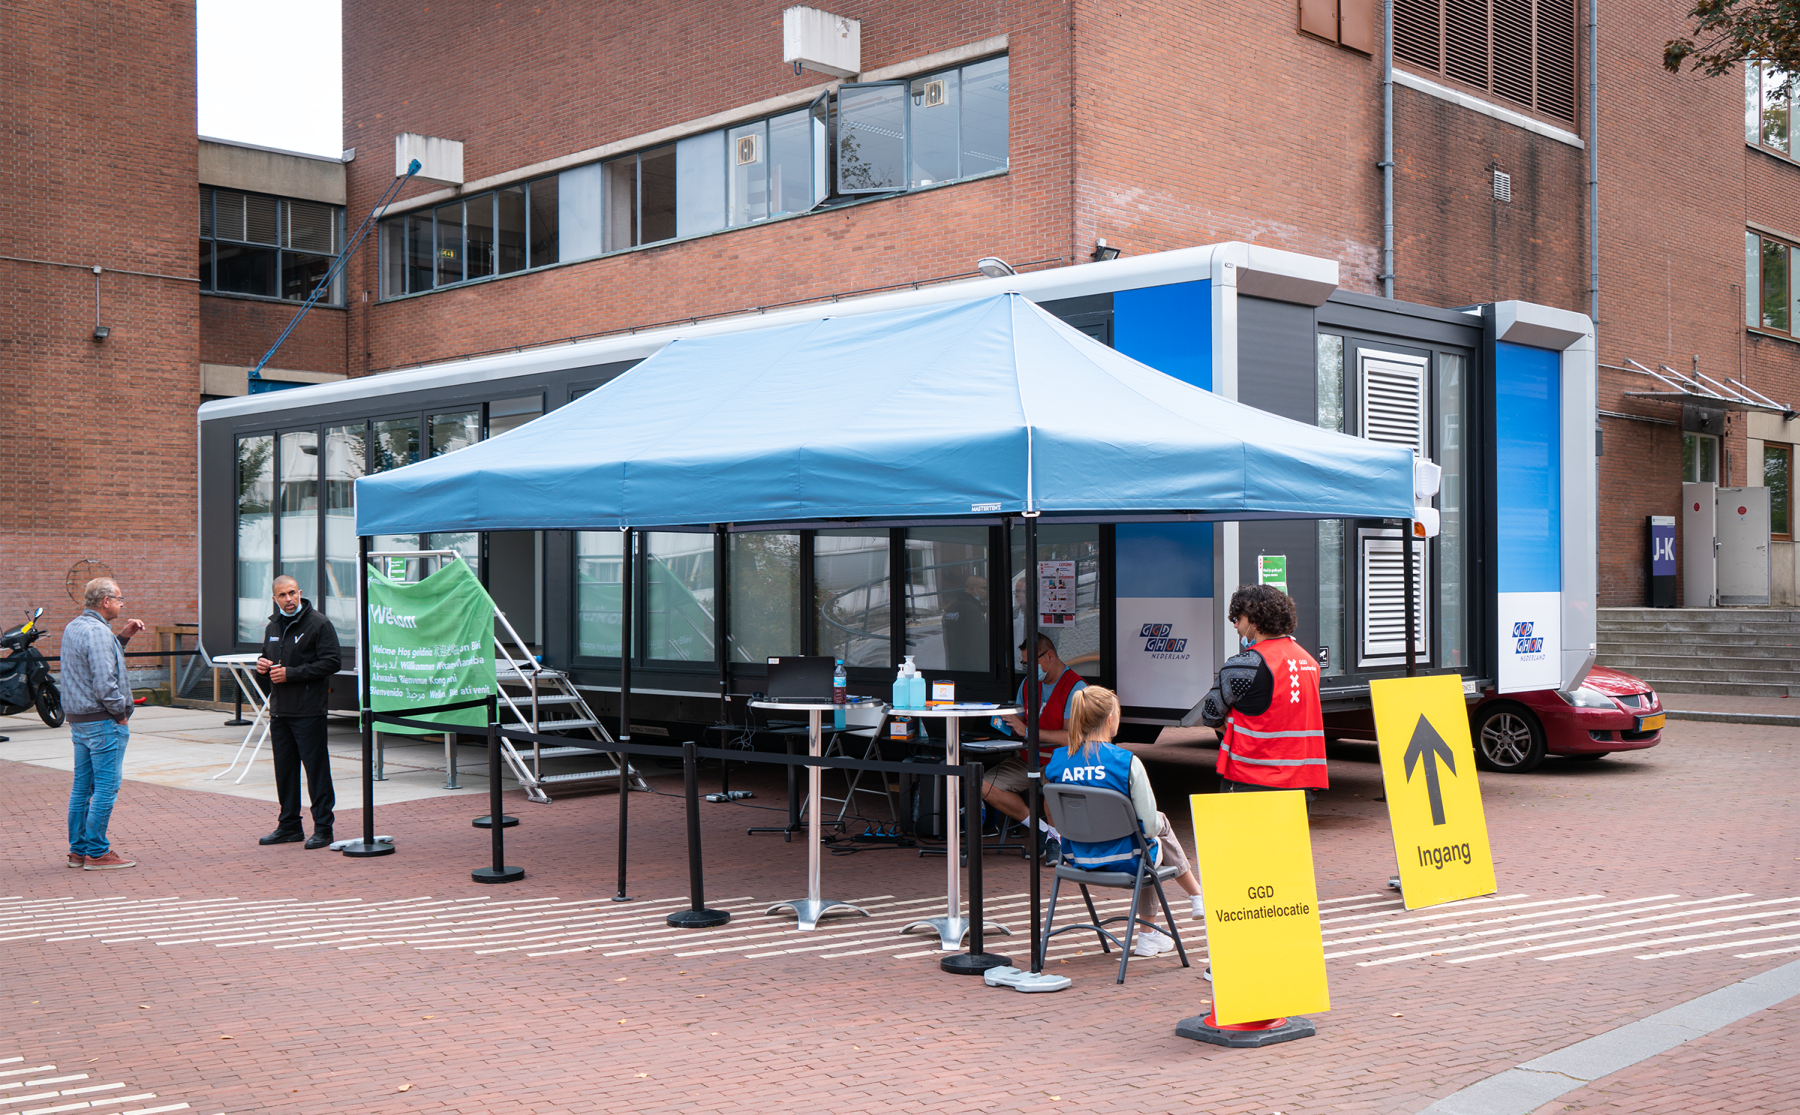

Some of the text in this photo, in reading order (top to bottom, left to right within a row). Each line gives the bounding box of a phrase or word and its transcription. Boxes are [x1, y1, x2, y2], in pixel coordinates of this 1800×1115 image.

[1654, 537, 1675, 561] J-K
[1141, 624, 1171, 636] GGD
[1513, 622, 1533, 636] GGD
[372, 644, 396, 656] Welcome
[1146, 638, 1186, 651] GHOR
[1517, 638, 1542, 653] GHOR
[372, 672, 398, 682] Akwaaba
[370, 686, 403, 697] Bienvenido
[1062, 766, 1106, 782] ARTS
[1417, 843, 1472, 870] Ingang
[1248, 886, 1274, 899] GGD
[1216, 902, 1310, 922] Vaccinatielocatie
